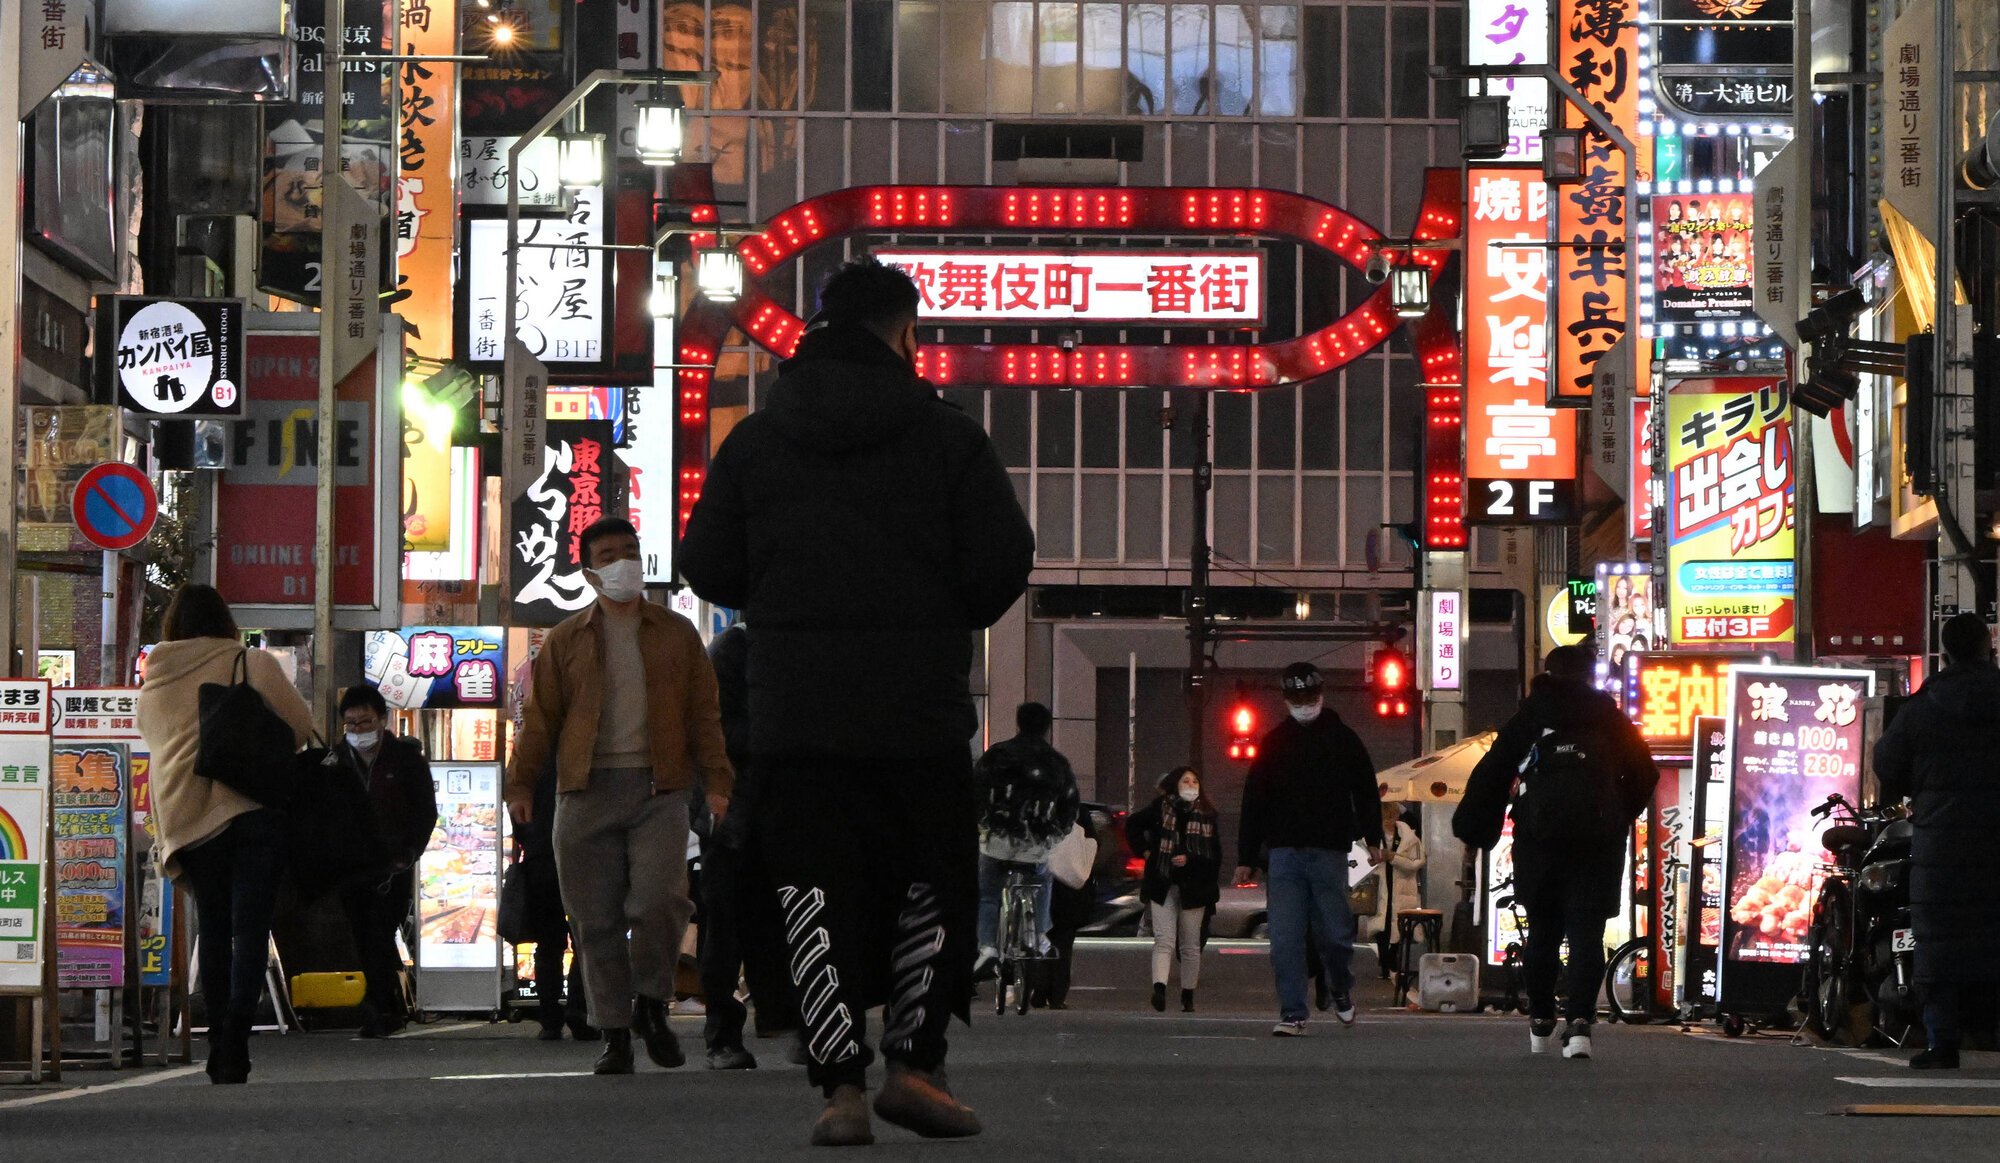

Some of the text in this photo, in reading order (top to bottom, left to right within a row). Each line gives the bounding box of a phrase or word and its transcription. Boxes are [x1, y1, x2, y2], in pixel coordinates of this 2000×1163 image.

[1675, 83, 1794, 105] 第一大滝ビル
[1898, 43, 1921, 188] 劇場通り一番街
[1766, 186, 1785, 304] 劇場通り一番街
[348, 223, 368, 339] 劇場通り一番街
[138, 322, 184, 341] 新宿酒場
[220, 307, 229, 336] FOOD
[475, 296, 498, 358] 一番街
[118, 331, 213, 371] カンパイ屋
[220, 344, 229, 379] DRINKS
[556, 340, 598, 358] B1F
[142, 361, 192, 376] KANPAIYA
[215, 387, 232, 400] B1
[522, 375, 539, 466] 劇場通り一番街
[1602, 372, 1616, 465] 劇場通り一番街
[1681, 379, 1788, 449] キラリ
[1487, 480, 1555, 515] 2F
[456, 639, 498, 656] フリー
[1438, 599, 1454, 681] 劇場通り
[0, 711, 40, 724] 所完備
[65, 696, 138, 713] 喫煙でき
[1, 764, 41, 784] 宣言
